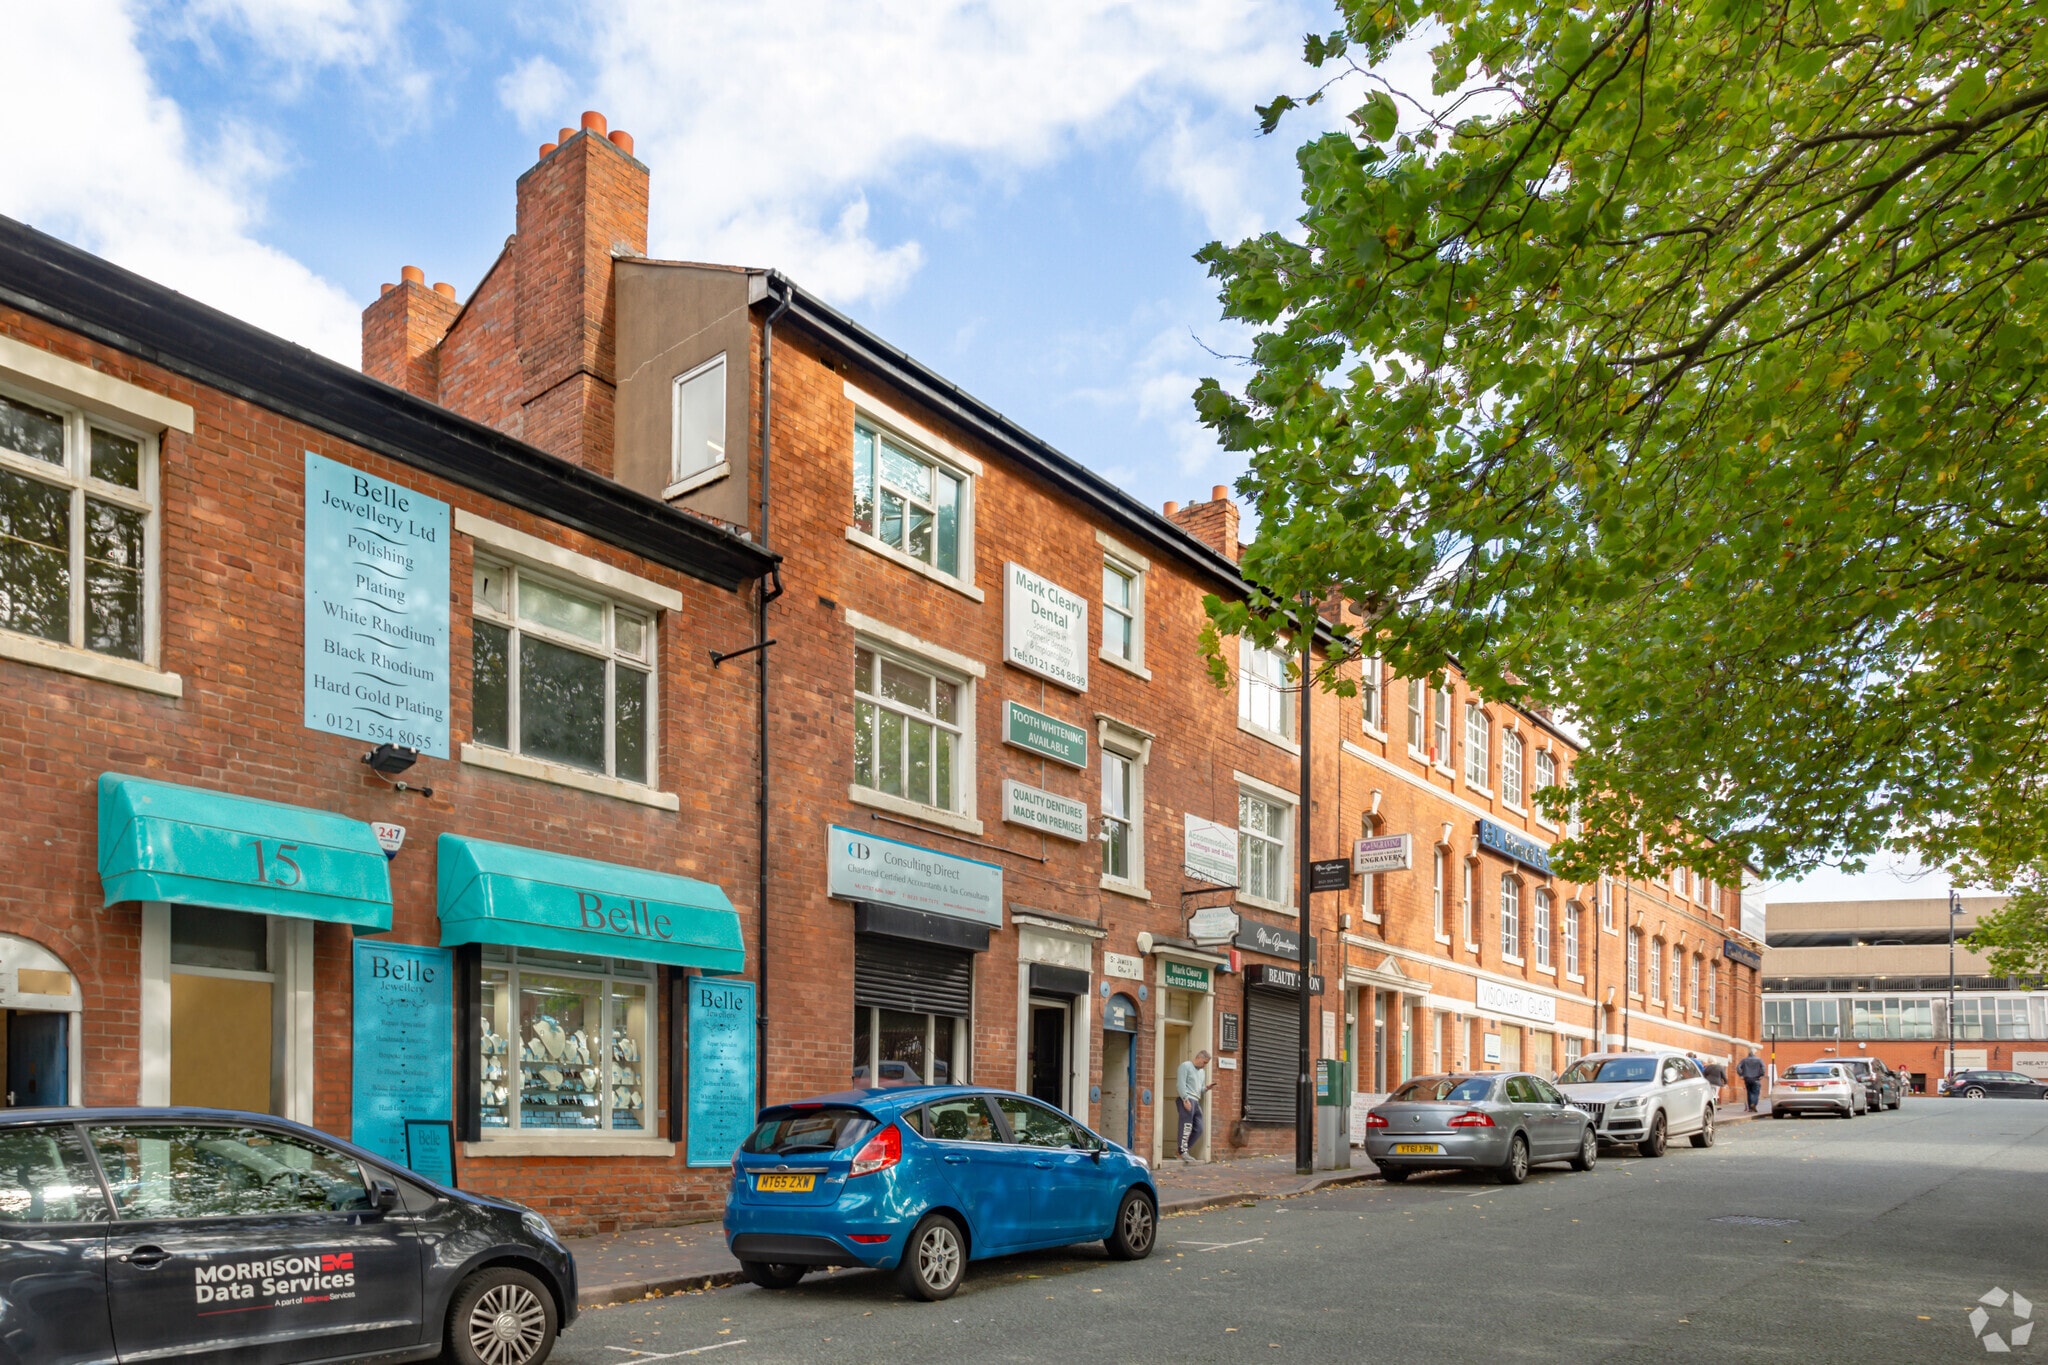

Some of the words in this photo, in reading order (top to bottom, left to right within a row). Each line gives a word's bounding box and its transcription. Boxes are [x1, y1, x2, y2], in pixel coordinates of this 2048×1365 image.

[353, 475, 410, 513] Belle
[322, 489, 402, 534] Jewellery
[409, 520, 436, 543] Ltd
[348, 534, 414, 572] Polishing
[356, 574, 406, 604] Plating
[1016, 570, 1045, 598] Mark
[1048, 588, 1082, 620] Cleary
[322, 600, 367, 626] White
[372, 614, 435, 647] Rhodium
[1031, 598, 1068, 630] Dental
[324, 638, 365, 663] Black
[371, 652, 434, 682] Rhodium
[1013, 647, 1027, 662] Tel:
[1029, 655, 1048, 671] 0121
[1050, 664, 1065, 678] 554
[1066, 671, 1086, 686] 8899
[313, 674, 350, 696] Hard
[355, 685, 390, 706] Gold
[396, 696, 443, 722] Plating
[326, 712, 361, 733] 0121
[368, 722, 393, 741] 554
[398, 729, 432, 749] 8055
[1012, 709, 1040, 729] TOOTH
[1041, 721, 1084, 745] WHITENING
[1028, 732, 1069, 756] AVAILABLE
[1013, 788, 1046, 806] QUALITY
[1046, 798, 1082, 819] DENTURES
[379, 826, 400, 840] 247
[1013, 805, 1035, 820] MADE
[1036, 812, 1048, 823] ON
[1049, 816, 1082, 834] PREMISES
[1189, 830, 1236, 852] Accommodation
[1190, 840, 1210, 853] Lettings
[1211, 847, 1220, 856] and
[1221, 850, 1234, 860] Sales
[247, 840, 301, 887] 15
[884, 852, 931, 876] Consulting
[934, 863, 960, 880] Direct
[1361, 854, 1402, 864] ENGRAVERS
[848, 864, 879, 878] Chartered
[880, 871, 906, 883] Certified
[907, 877, 942, 891] Accountants
[950, 886, 958, 895] Tax
[960, 888, 990, 902] Consultants
[575, 891, 674, 940] Belle
[372, 956, 435, 983] Belle
[1172, 964, 1185, 975] Mark
[1186, 966, 1202, 979] Cleary
[1268, 968, 1296, 986] BEAUTY
[1298, 975, 1320, 991] SON
[380, 981, 424, 995] Jewellery
[701, 989, 743, 1010] Belle
[1482, 985, 1524, 1010] VISIONARY
[1528, 996, 1550, 1017] GLASS
[706, 1009, 736, 1019] Jewellery
[419, 1130, 440, 1146] Belle
[761, 1175, 786, 1188] MT65
[789, 1175, 811, 1188] ZXW
[195, 1256, 320, 1284] MORRISON
[196, 1282, 254, 1304] Data
[262, 1272, 355, 1296] Services
